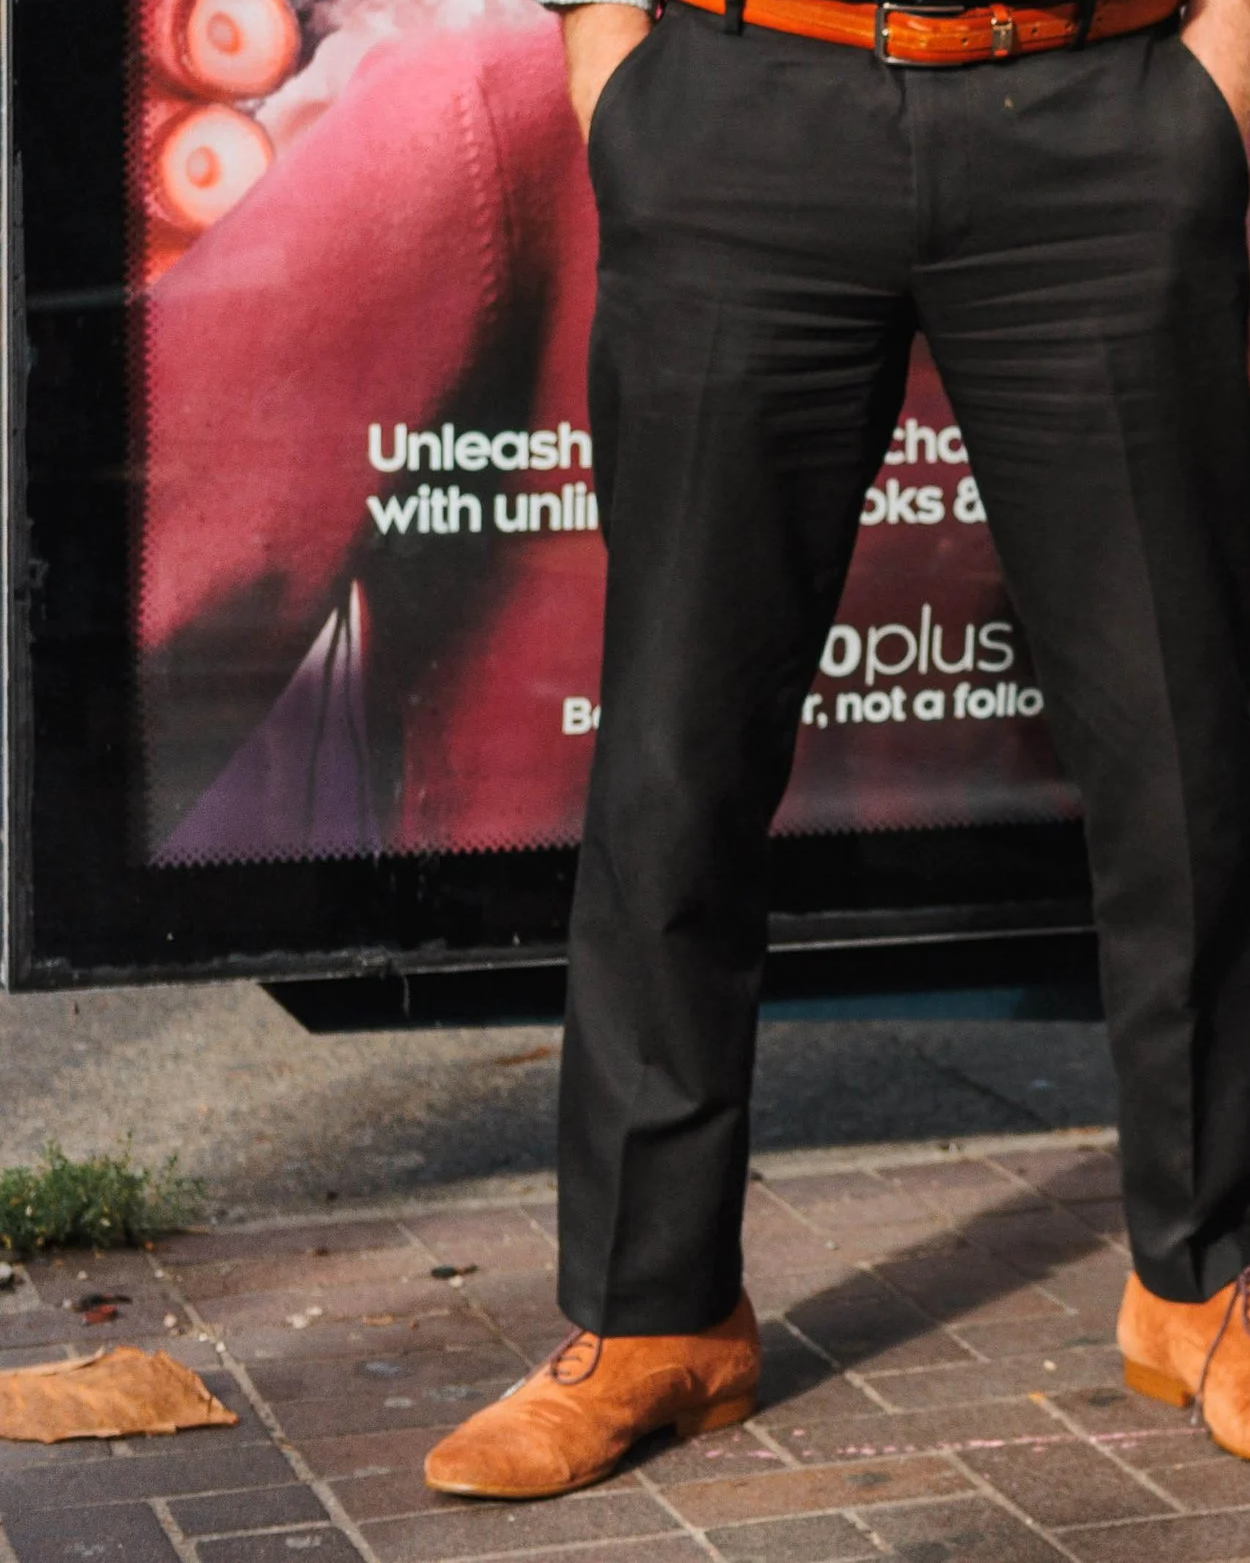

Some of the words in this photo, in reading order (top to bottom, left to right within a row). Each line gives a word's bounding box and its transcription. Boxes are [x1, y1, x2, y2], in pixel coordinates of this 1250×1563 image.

[368, 421, 593, 472] Unleash
[366, 483, 482, 535] with
[953, 476, 987, 524] &
[836, 685, 907, 724] not
[912, 689, 945, 721] a
[953, 681, 1044, 720] follo
